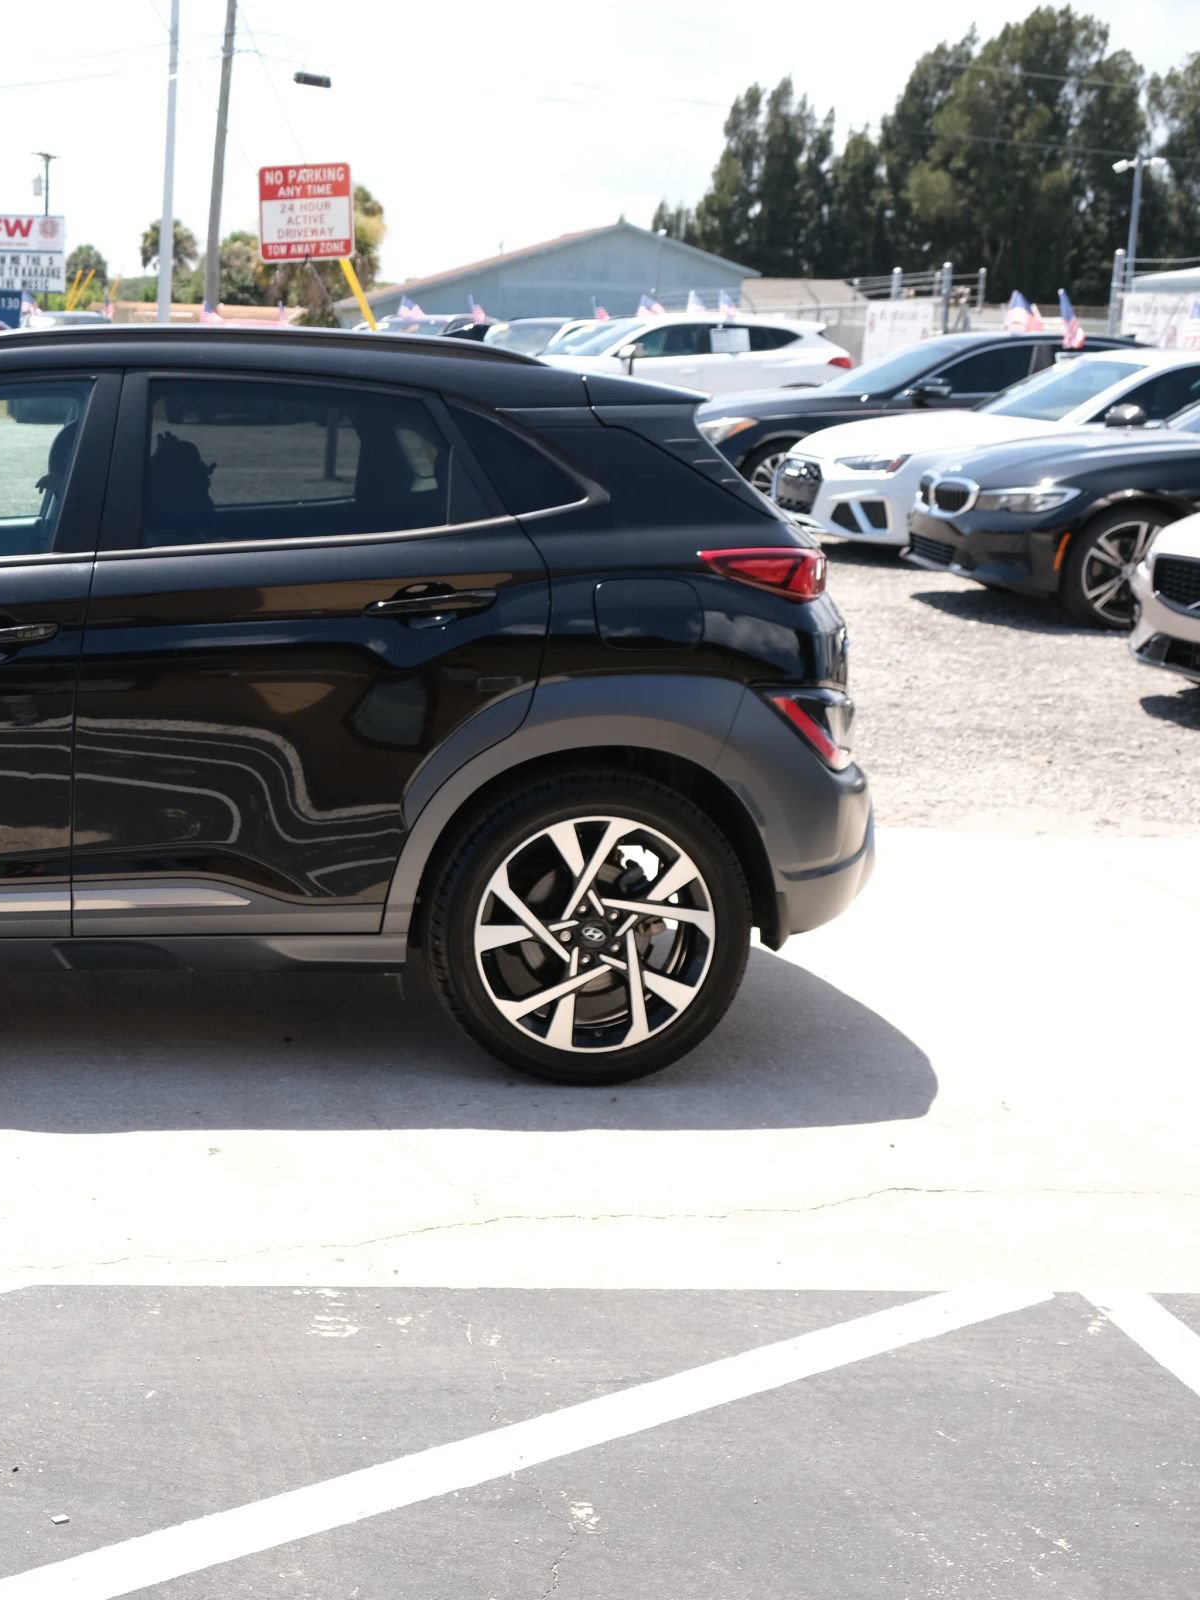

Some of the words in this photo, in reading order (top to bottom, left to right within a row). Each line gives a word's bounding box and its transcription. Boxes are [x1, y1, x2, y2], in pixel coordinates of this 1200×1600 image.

[264, 170, 284, 185] NO
[287, 167, 345, 183] PARKING
[277, 186, 302, 198] ANY
[307, 184, 333, 195] TIME
[280, 203, 295, 213] 24
[300, 200, 331, 211] HOUR
[287, 214, 325, 225] ACTIVE
[277, 226, 334, 239] DRIVEWAY
[267, 244, 287, 256] TOW
[290, 242, 316, 254] AWAY
[319, 241, 345, 252] ZONE
[10, 256, 21, 266] ME
[26, 255, 41, 266] THE
[21, 280, 49, 290] MUSIC
